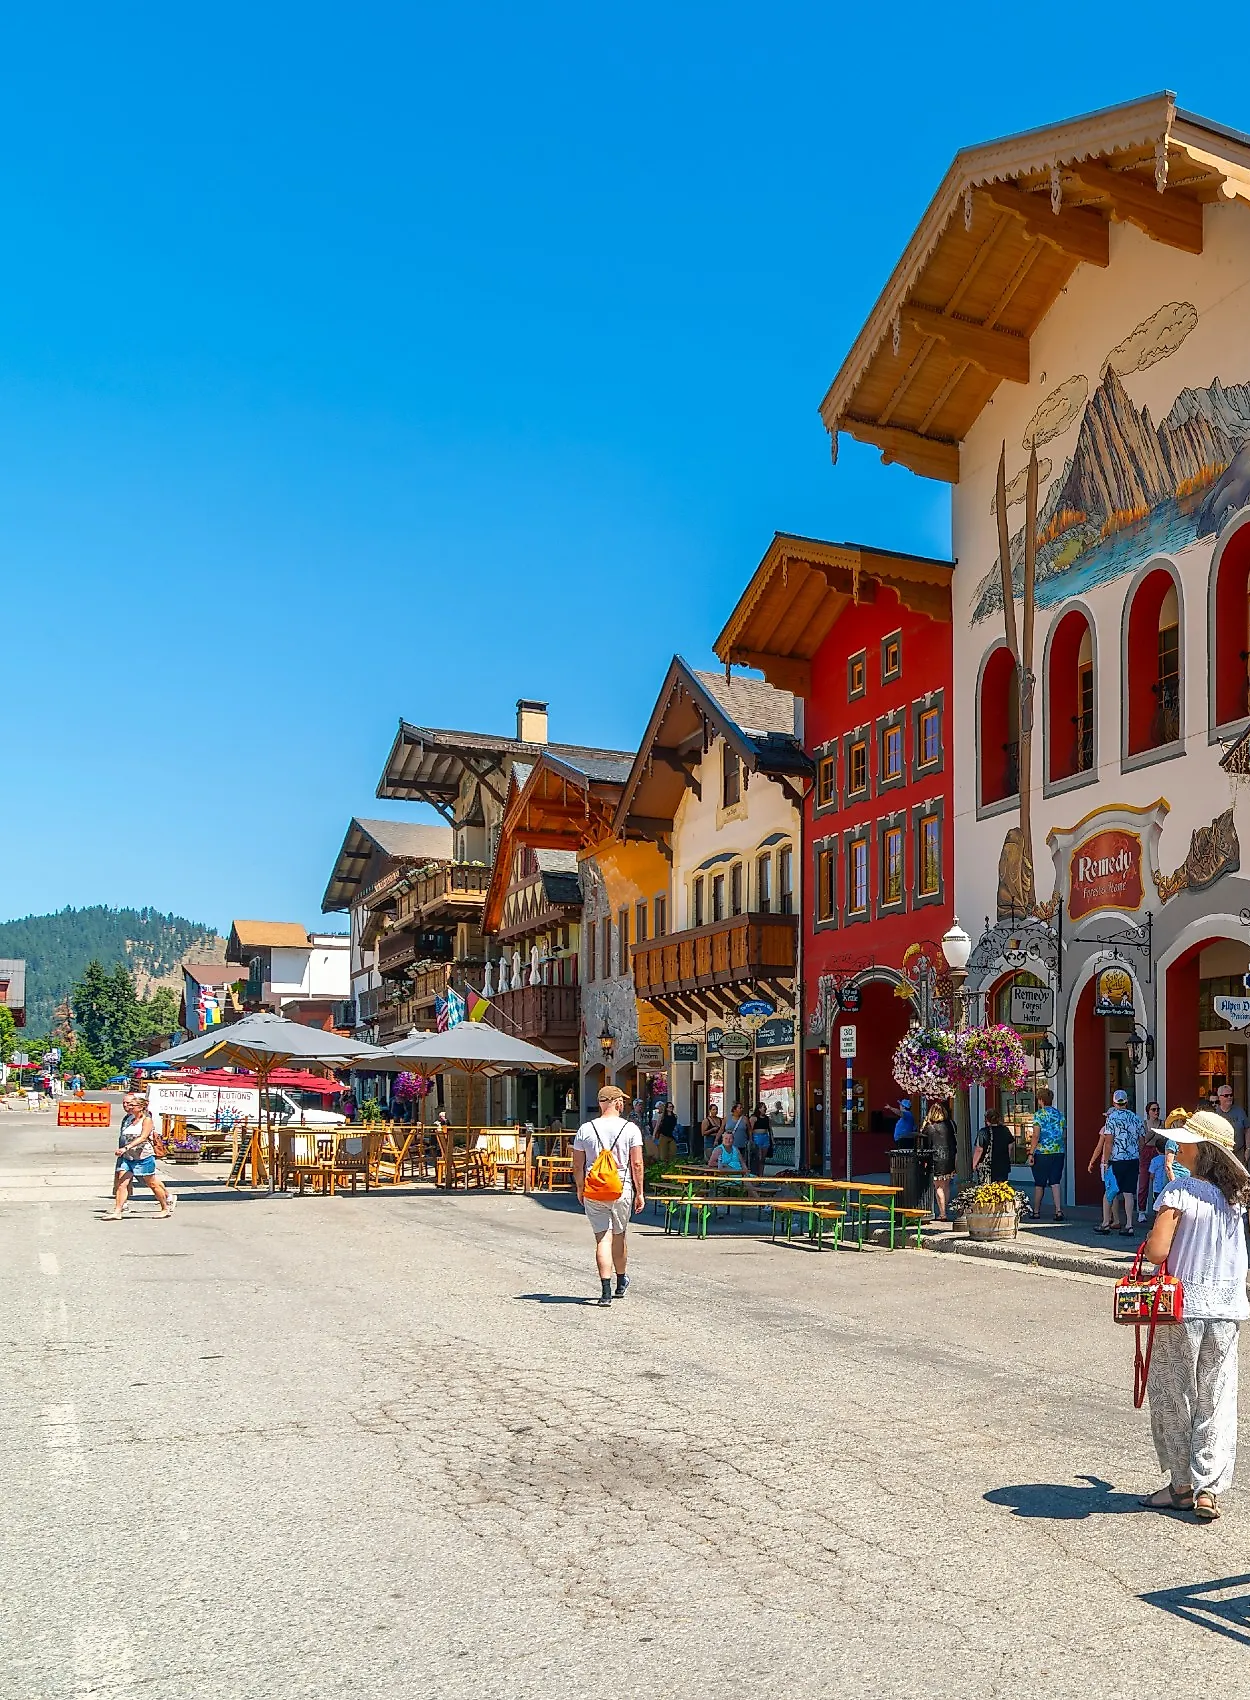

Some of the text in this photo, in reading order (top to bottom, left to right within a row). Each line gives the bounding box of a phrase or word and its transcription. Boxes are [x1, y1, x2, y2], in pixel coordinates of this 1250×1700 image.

[1078, 848, 1132, 883] Remedy
[1014, 988, 1050, 1004] Remedy
[1022, 1001, 1042, 1010] Forest
[1221, 1000, 1241, 1012] Alpen
[1023, 1014, 1041, 1022] Home
[843, 1028, 853, 1036] 30
[197, 1091, 209, 1099] AIR
